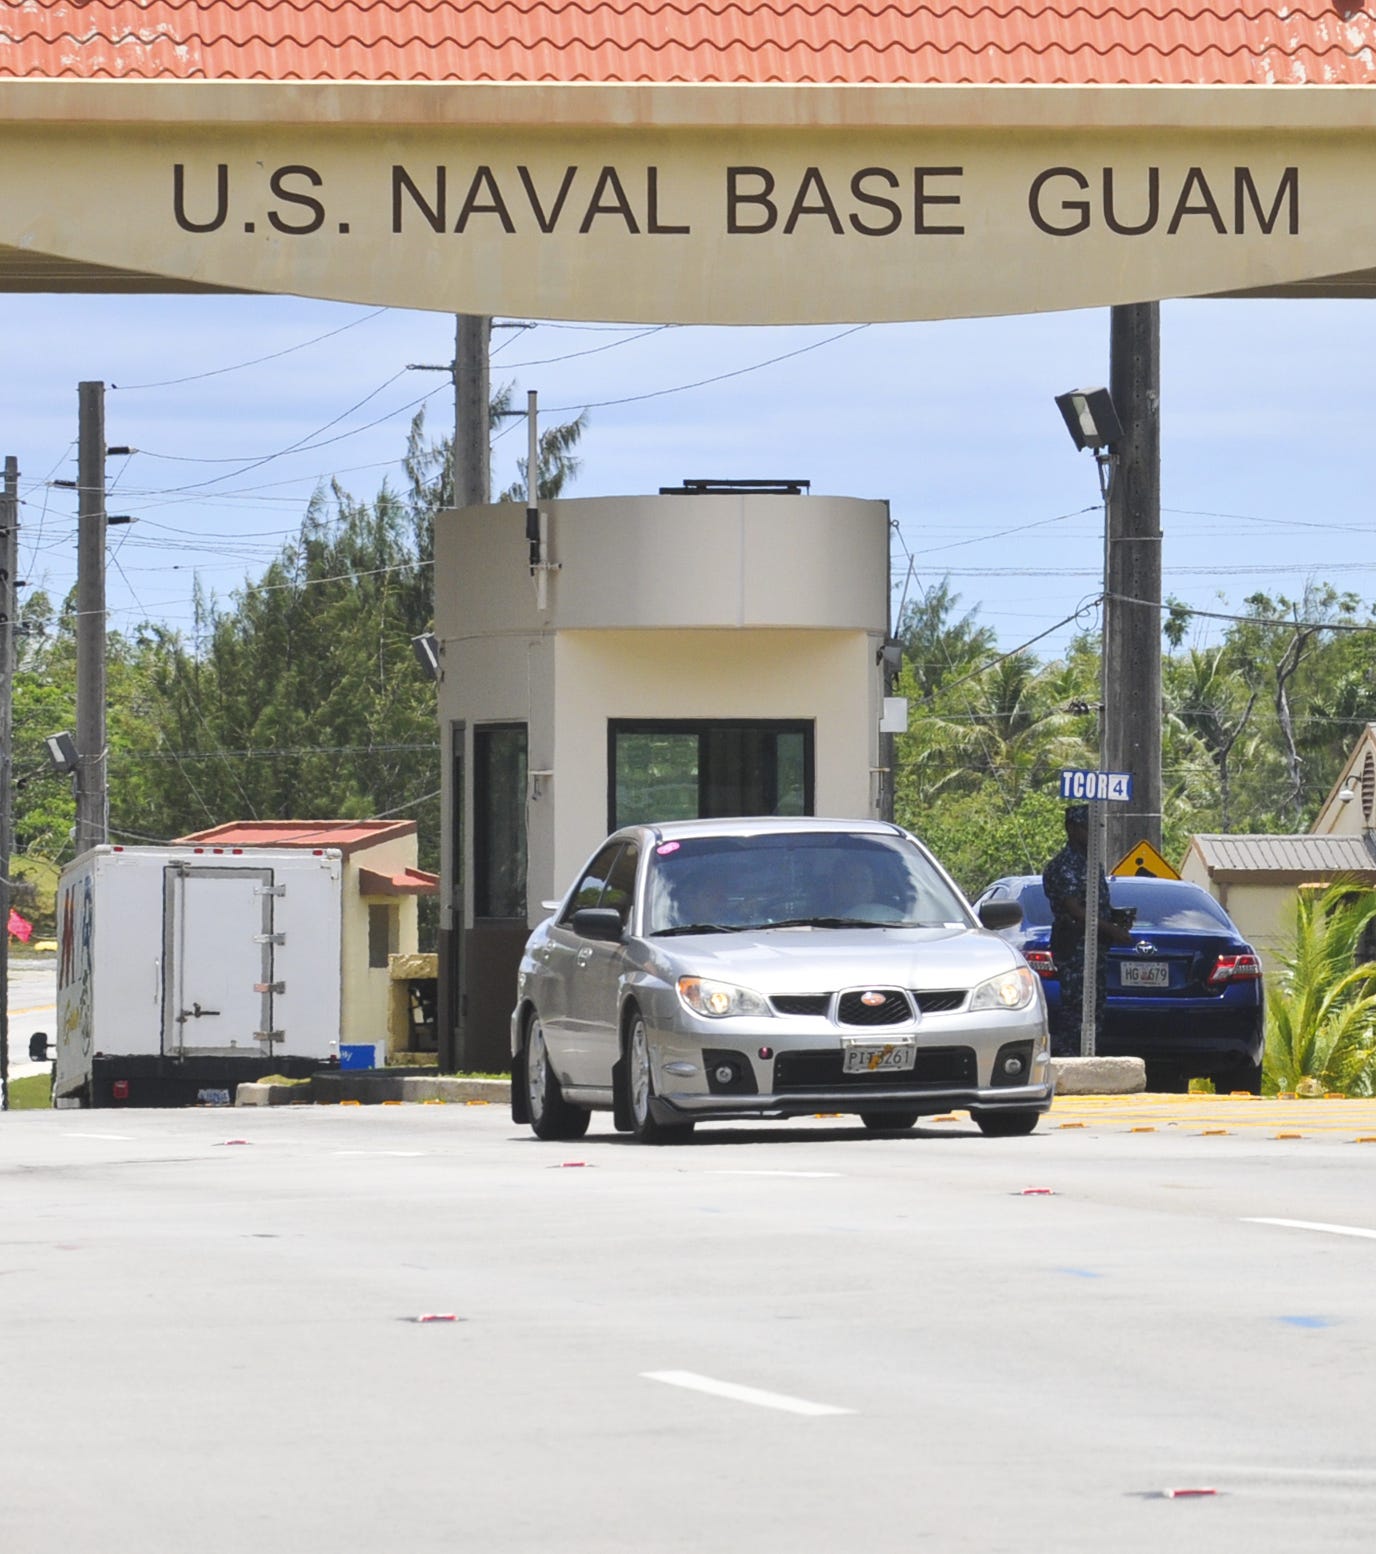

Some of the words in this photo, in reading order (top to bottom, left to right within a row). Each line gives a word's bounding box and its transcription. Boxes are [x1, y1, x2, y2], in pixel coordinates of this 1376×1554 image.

[173, 164, 350, 235] U.S.
[391, 165, 691, 235] NAVAL
[726, 166, 965, 236] BASE
[1028, 166, 1299, 236] GUAM
[1063, 771, 1107, 799] TCOR
[1113, 780, 1123, 796] 4
